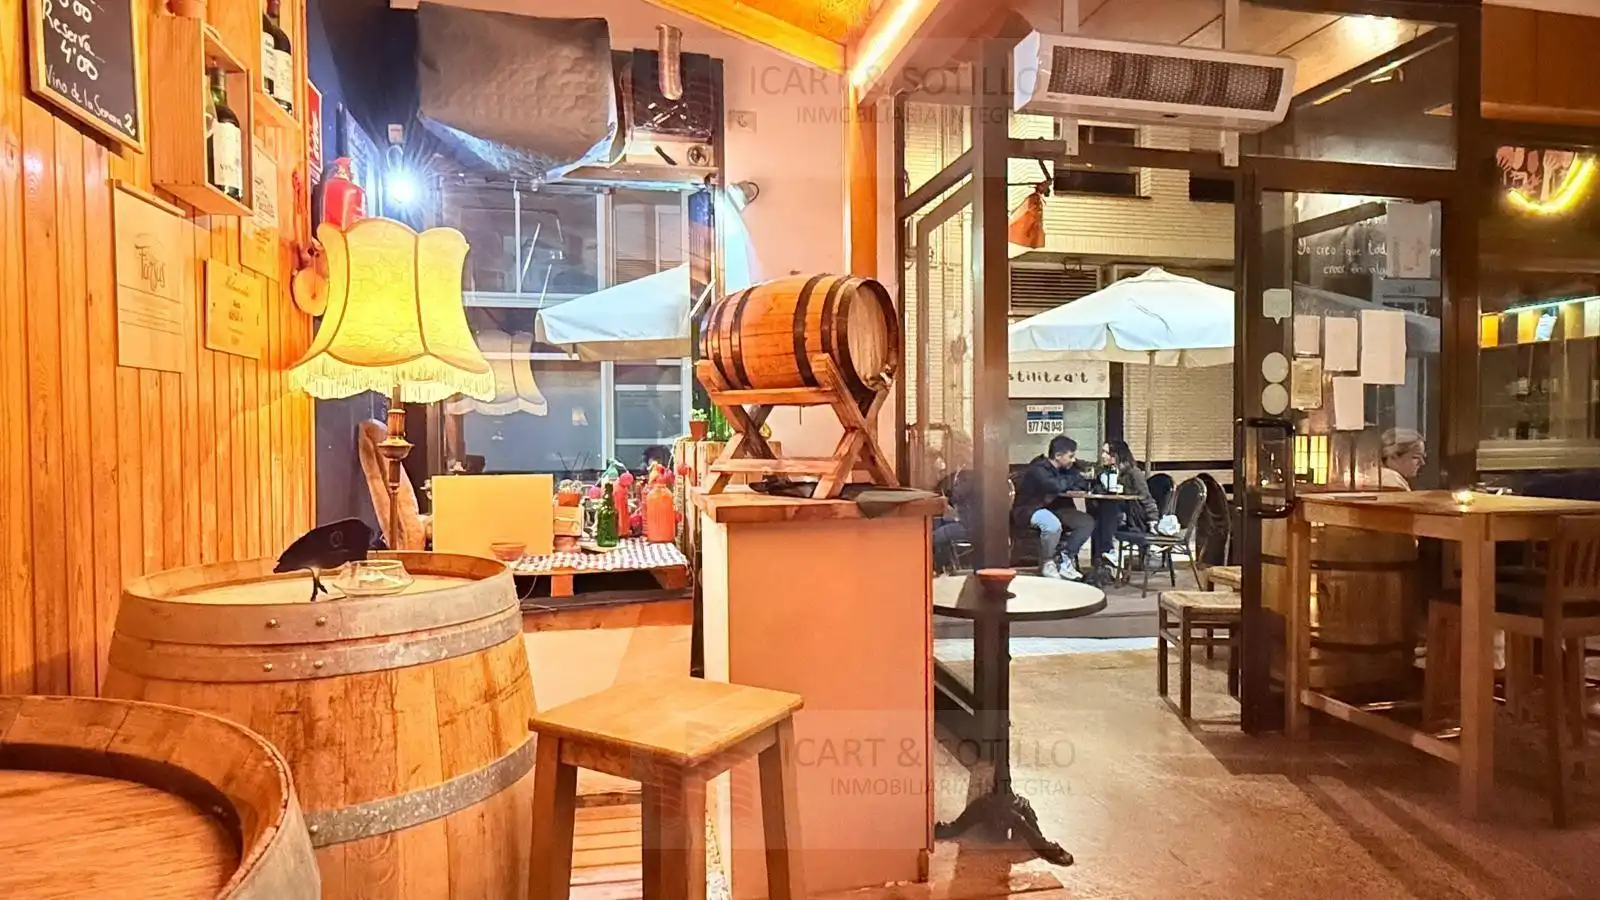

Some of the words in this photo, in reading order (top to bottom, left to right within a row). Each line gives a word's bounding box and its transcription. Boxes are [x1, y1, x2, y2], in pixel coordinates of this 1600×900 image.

[42, 0, 97, 56] Reserva
[60, 39, 98, 80] 4'00
[46, 64, 68, 94] Vino
[70, 82, 82, 103] de
[83, 87, 93, 111] la
[1368, 240, 1387, 256] tod
